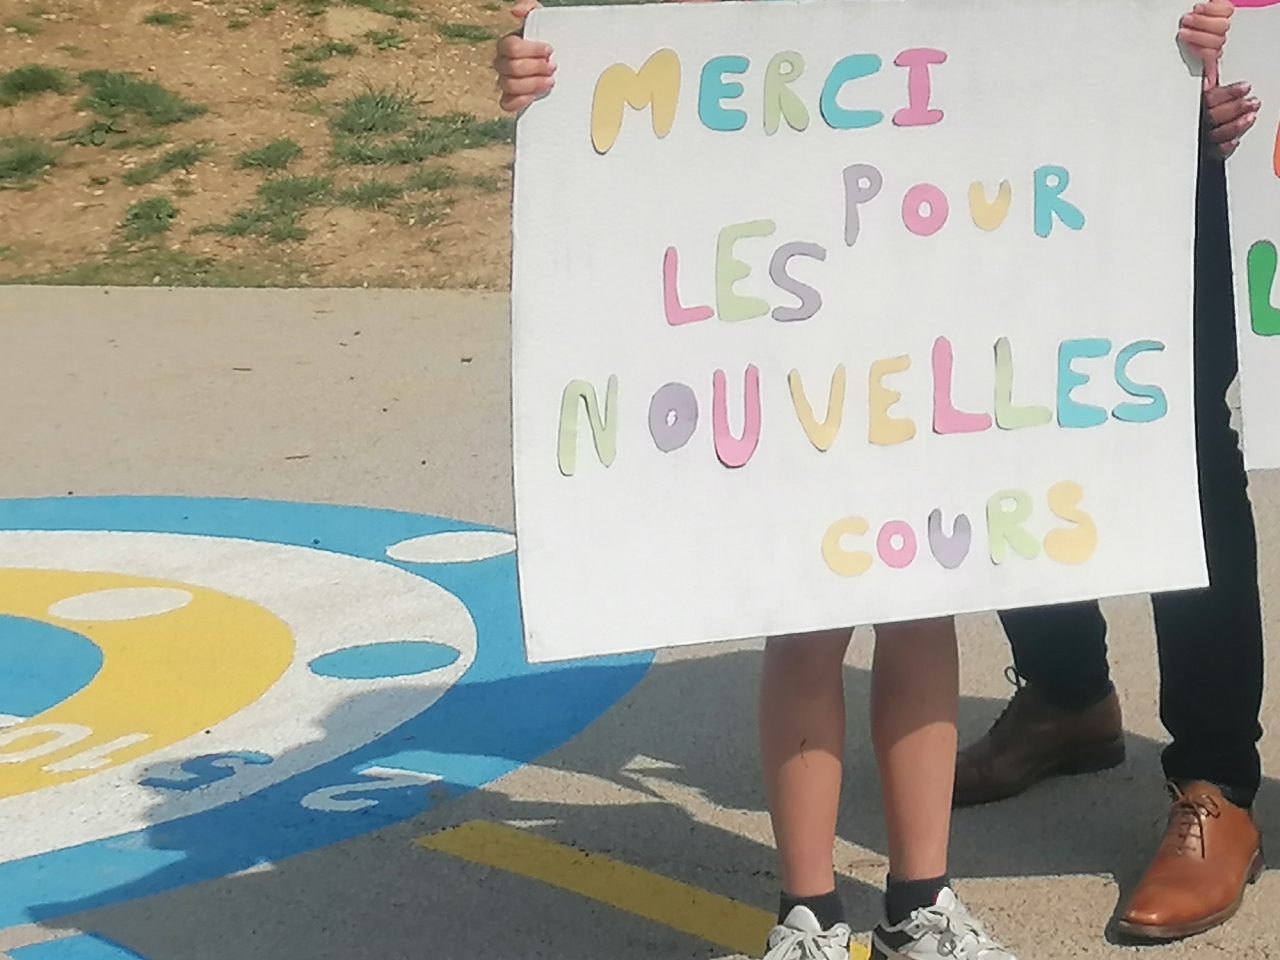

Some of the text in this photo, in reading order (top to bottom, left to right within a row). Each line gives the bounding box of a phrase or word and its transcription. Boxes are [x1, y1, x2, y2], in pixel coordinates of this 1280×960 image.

[591, 48, 947, 154] MERCI
[843, 164, 1085, 246] POUR
[662, 219, 826, 326] LES
[557, 336, 1168, 476] NOUVELLES
[821, 481, 1098, 577] COURS
[137, 750, 274, 791] 5
[301, 766, 443, 811] 2
